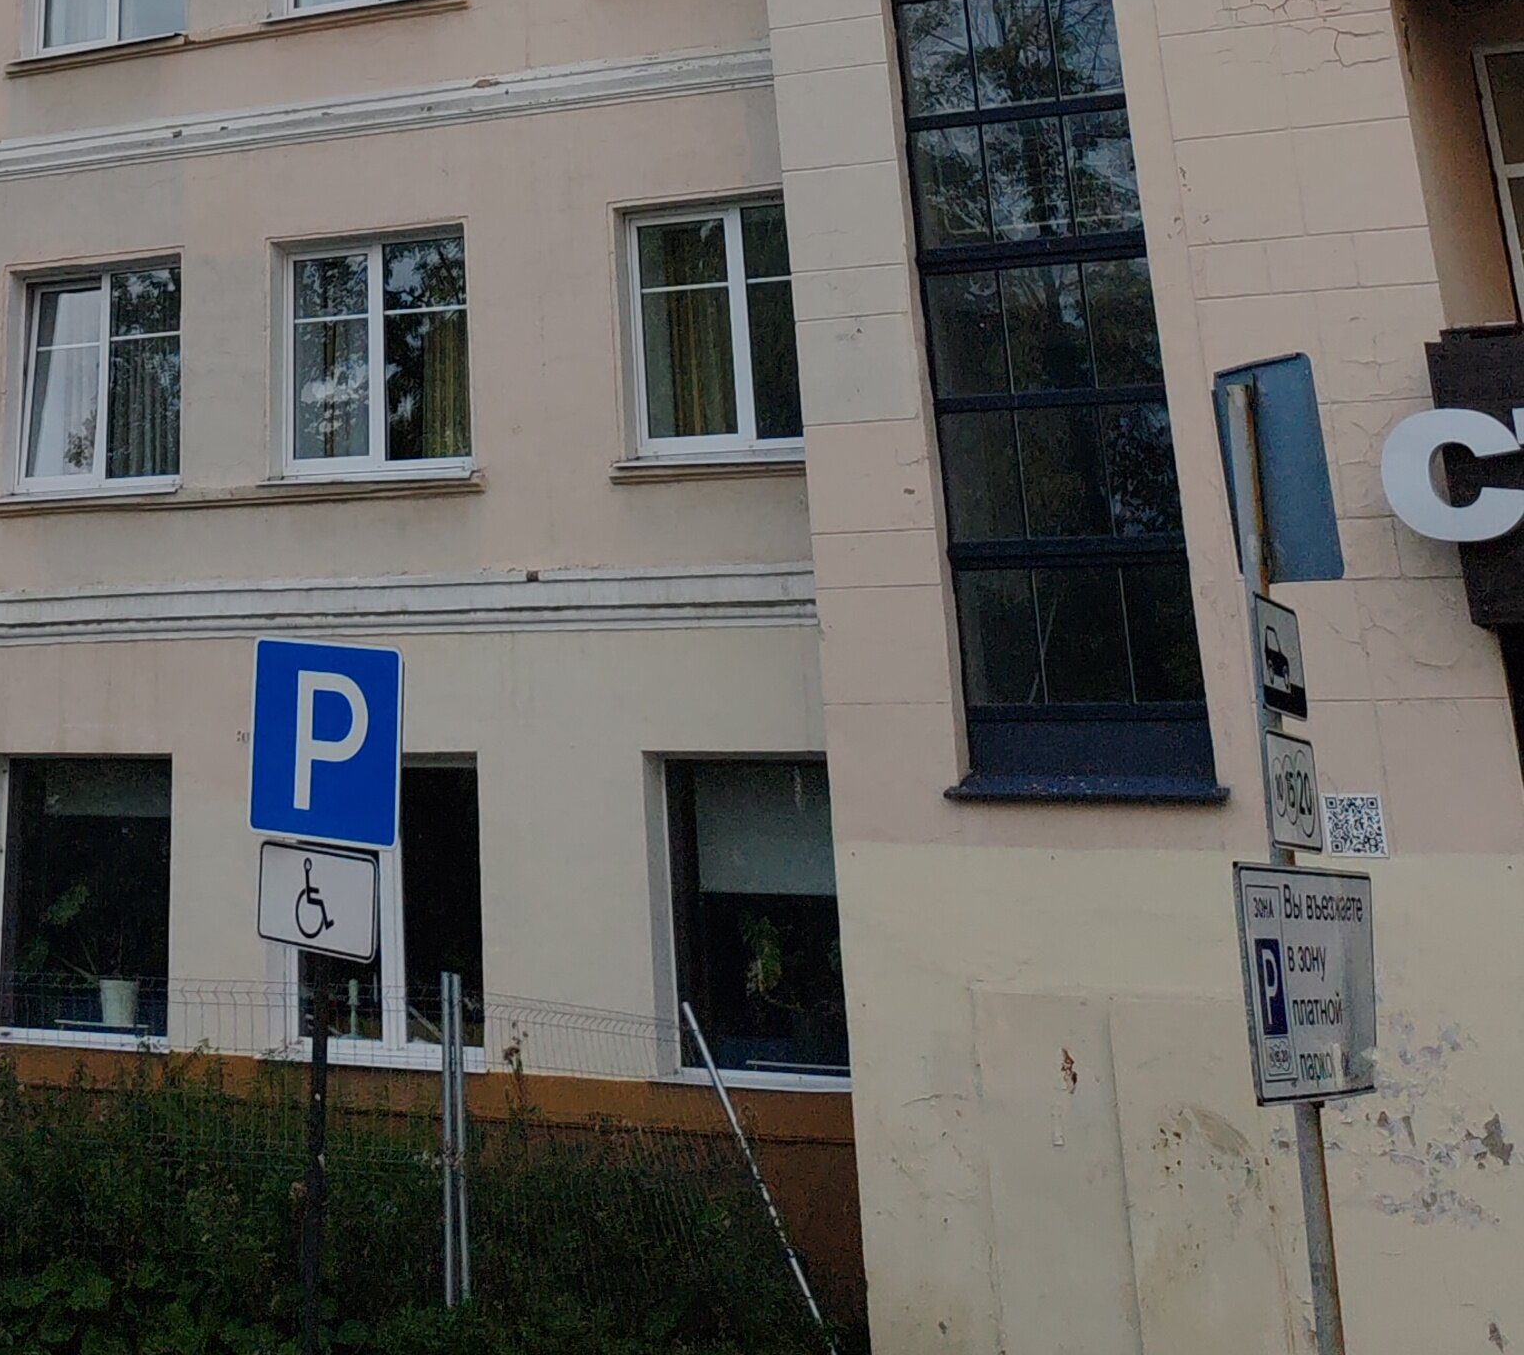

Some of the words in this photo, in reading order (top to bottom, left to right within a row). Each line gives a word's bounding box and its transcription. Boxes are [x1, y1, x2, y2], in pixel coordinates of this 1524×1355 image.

[292, 669, 369, 811] P
[1296, 769, 1313, 816] 20
[1253, 896, 1275, 919] ЗОНА
[1283, 884, 1303, 920] Вы
[1297, 946, 1326, 982] зону
[1292, 990, 1344, 1026] платной
